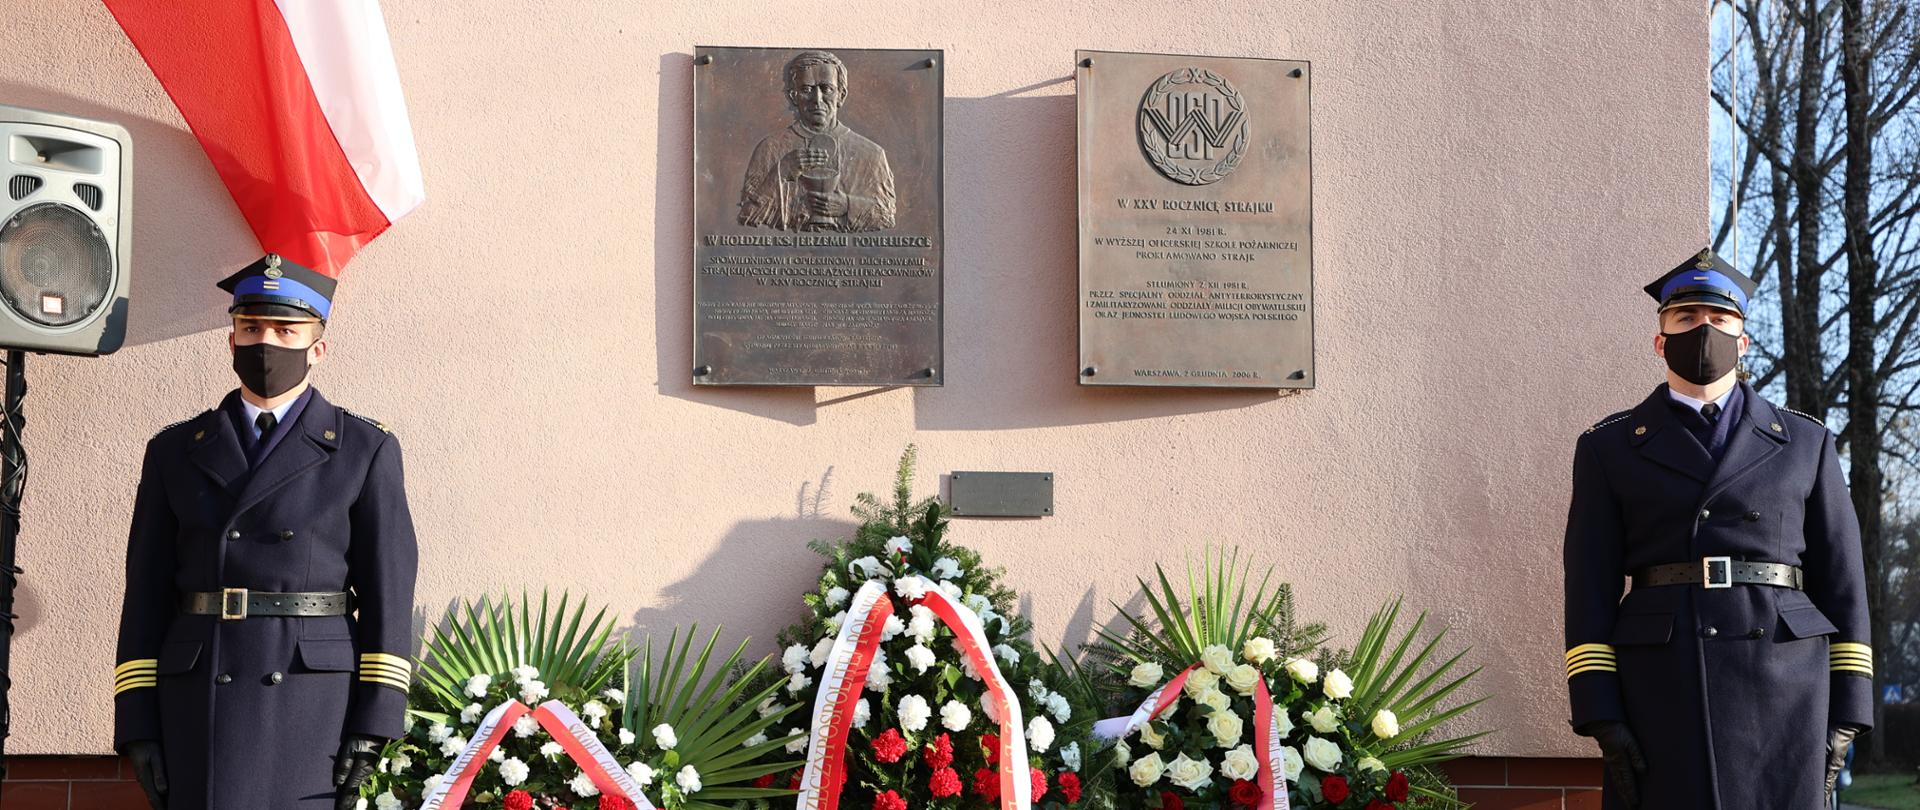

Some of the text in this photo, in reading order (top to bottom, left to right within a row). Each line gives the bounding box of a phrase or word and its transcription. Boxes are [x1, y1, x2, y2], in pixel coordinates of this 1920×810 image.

[1116, 198, 1275, 215] W XXV ROCZNICĘ STRAJKU
[1166, 227, 1228, 237] 24 XI 1981 R.
[704, 235, 719, 247] W
[774, 236, 794, 248] KS.
[794, 236, 849, 249] JERZEMU
[1094, 236, 1299, 252] W WYŻSZEJ OFICERSKIEJ SZKOLE POŻARNICZEJ
[1136, 251, 1256, 263] PROKLAMOWANO STRAJK
[757, 278, 768, 287] W
[771, 278, 792, 288] XXV
[842, 279, 883, 289] STRAJKU
[1146, 281, 1195, 289] STŁUMIONY
[1089, 290, 1115, 299] PRZEZ
[1119, 291, 1163, 300] SPECJALNY
[1208, 292, 1305, 301] ANTYTERRORYSTYCZNY
[1090, 301, 1168, 309] ZMILITARYZOWANE
[1214, 302, 1244, 312] MILICJI
[1245, 303, 1307, 313] OBYWATELSKIEJ
[1095, 310, 1299, 322] ORAZ JEDNOSTKI LUDOWEGO WOJSKA POLSKIEGO
[1190, 370, 1228, 378] GRUDNIA
